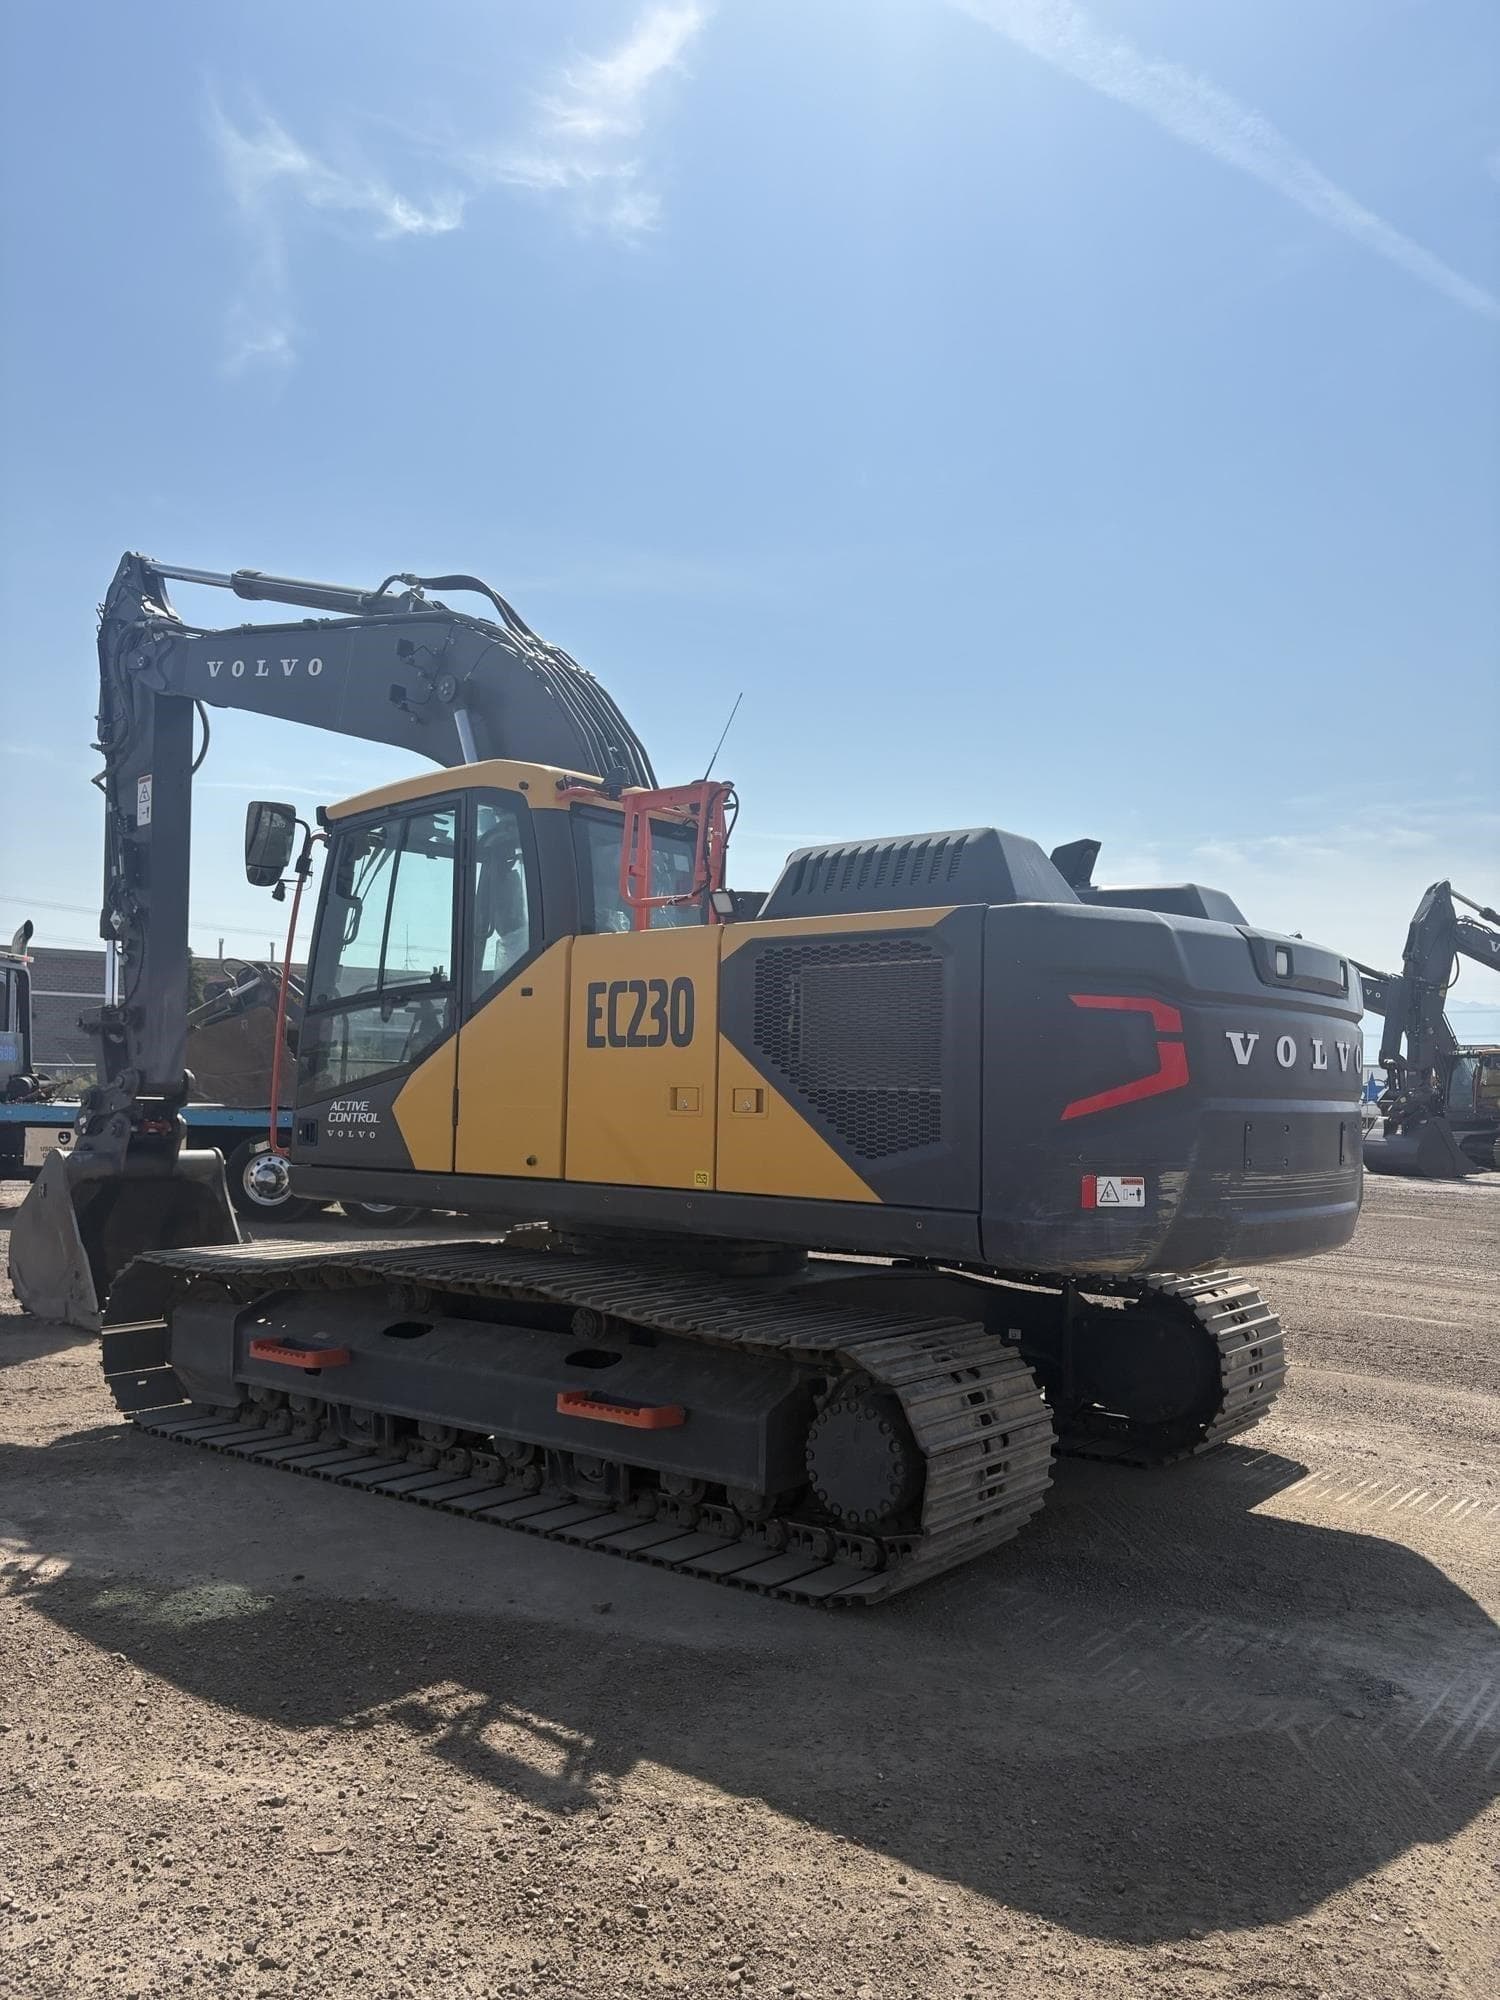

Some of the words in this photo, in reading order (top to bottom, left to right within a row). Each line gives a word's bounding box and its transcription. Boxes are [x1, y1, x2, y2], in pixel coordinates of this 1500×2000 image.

[206, 658, 323, 677] VOLVO
[586, 976, 695, 1048] EC230
[1225, 1031, 1362, 1074] VOLVO
[329, 1100, 370, 1111] ACTIVE
[328, 1112, 381, 1123] CONTROL
[327, 1129, 376, 1139] VOLVO
